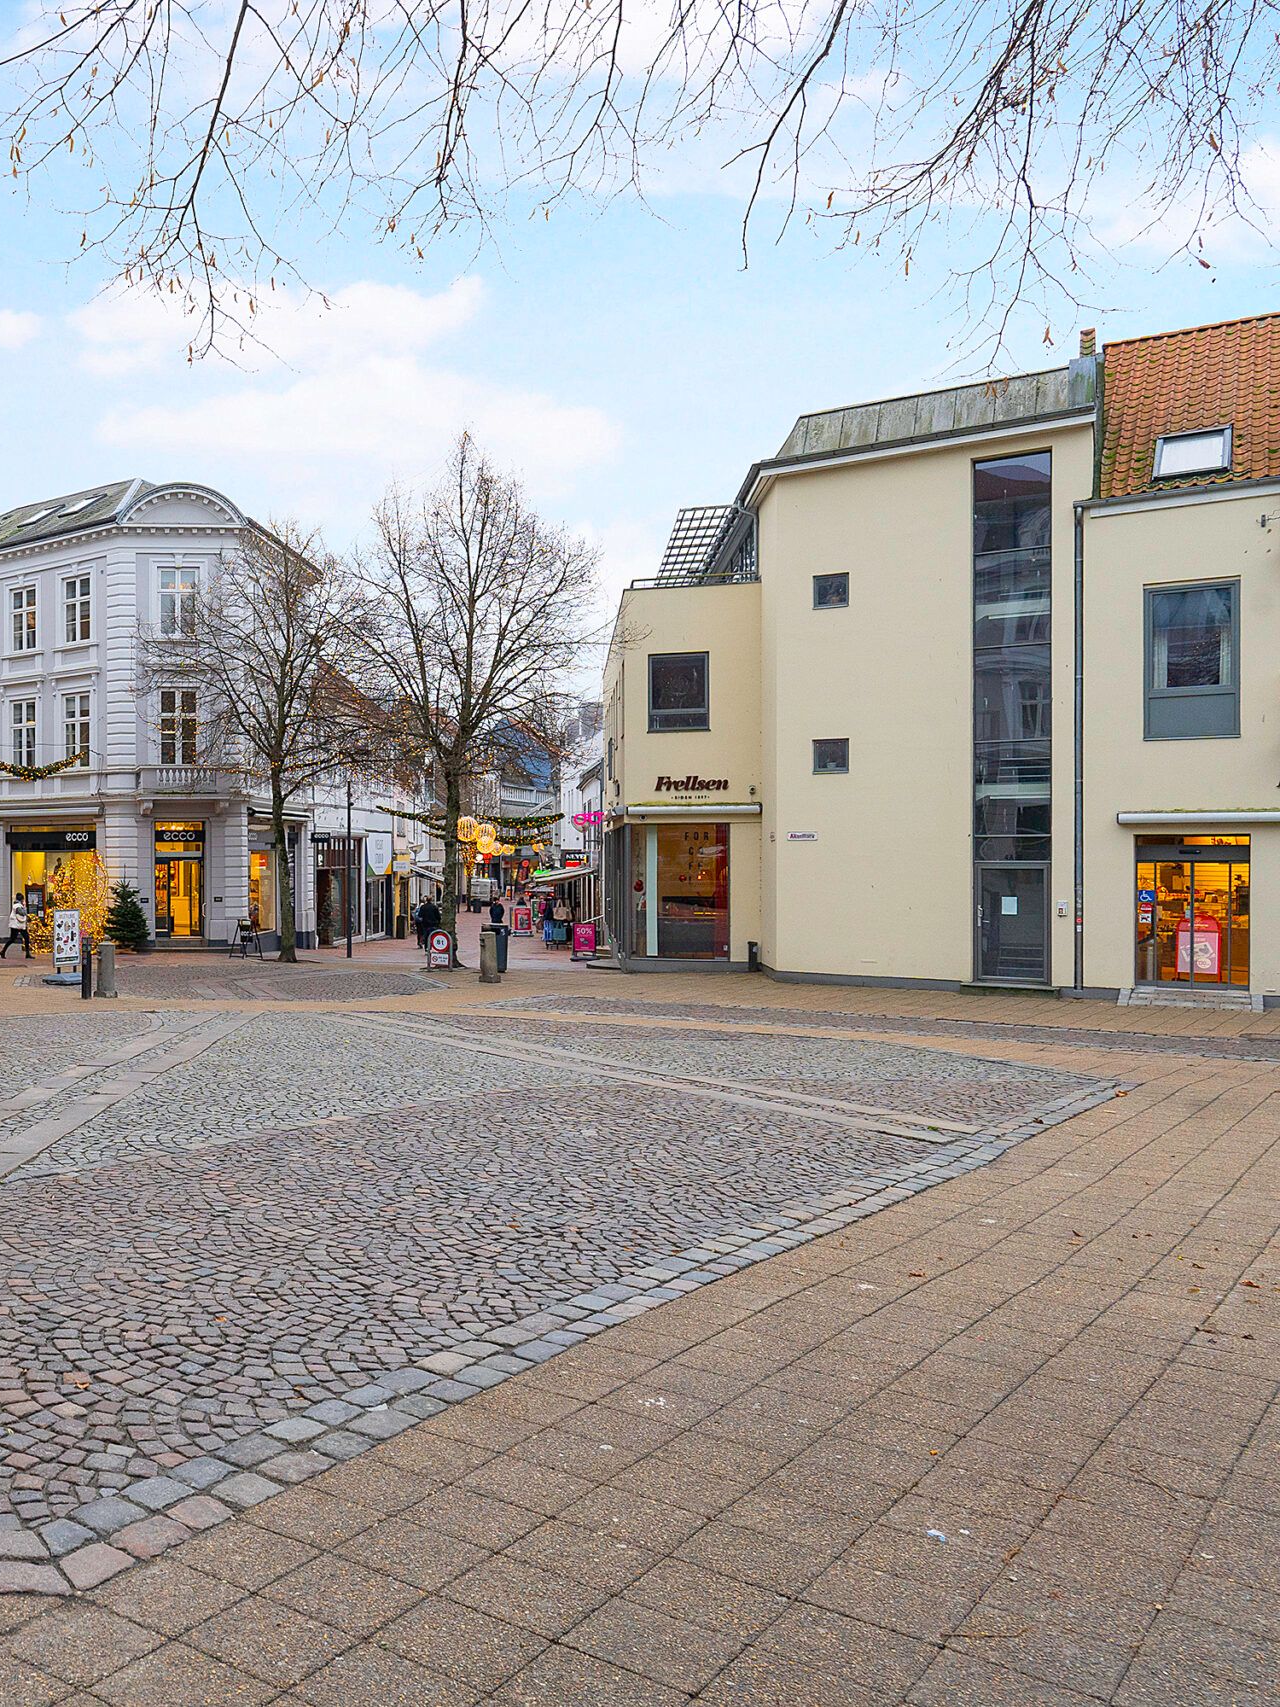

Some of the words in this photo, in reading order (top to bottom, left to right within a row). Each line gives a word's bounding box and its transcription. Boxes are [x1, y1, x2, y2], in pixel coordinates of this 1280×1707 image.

[654, 775, 729, 792] Frellsen
[65, 832, 89, 842] ecco
[163, 831, 196, 841] ecco
[684, 831, 710, 841] FOR
[576, 927, 593, 935] 50%
